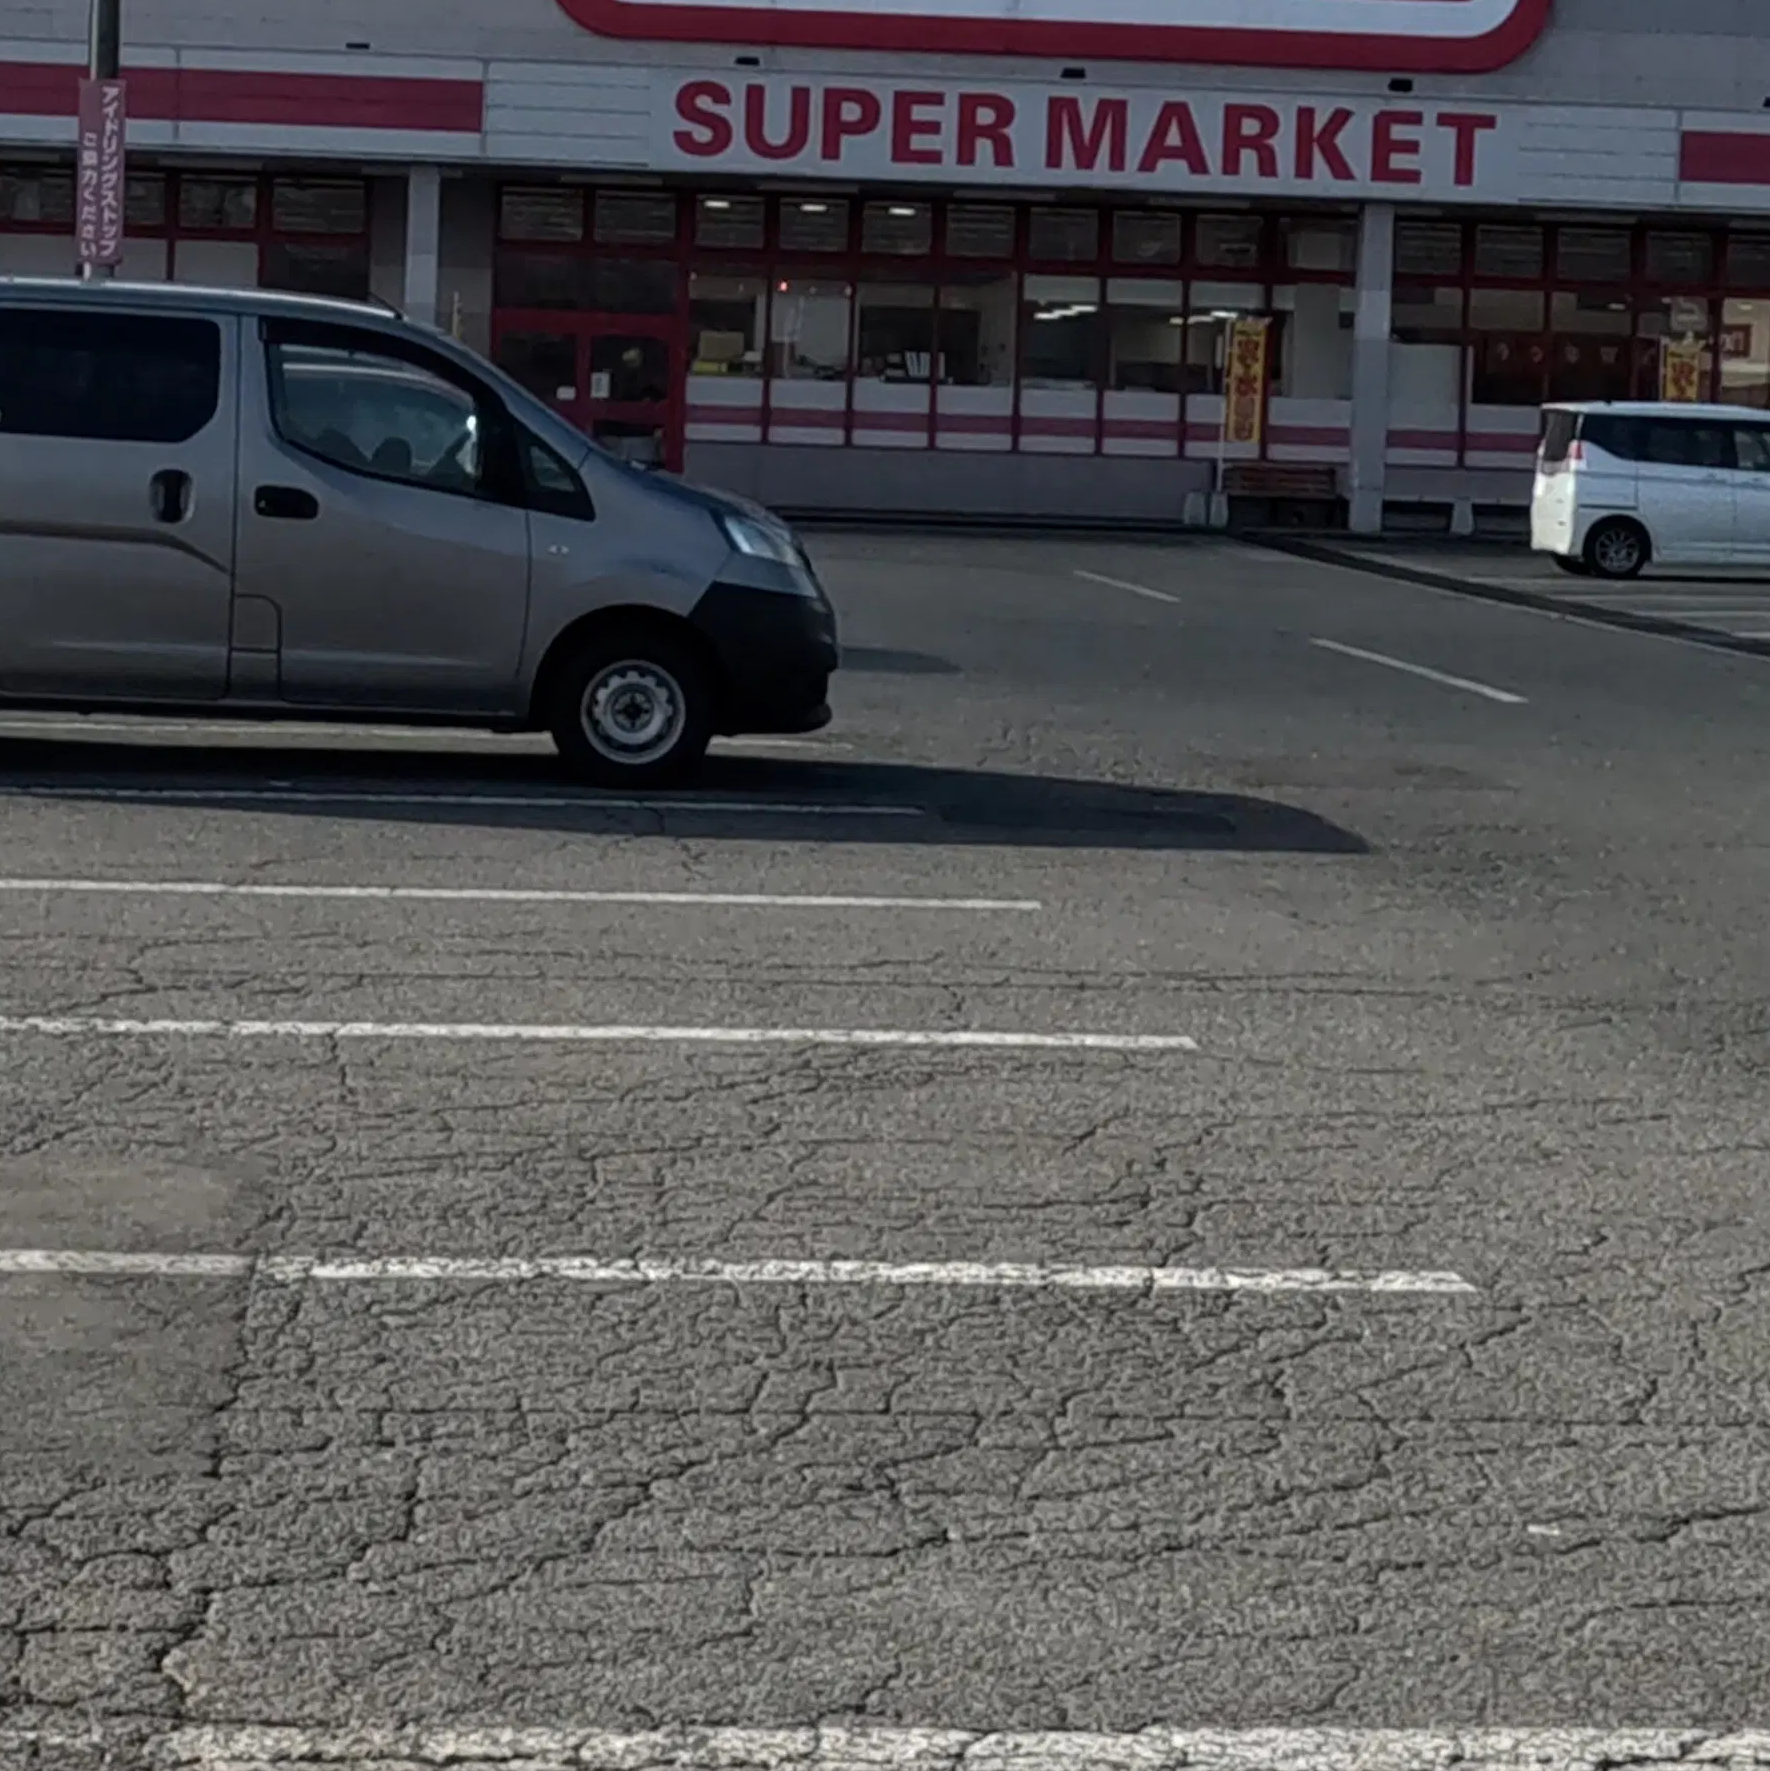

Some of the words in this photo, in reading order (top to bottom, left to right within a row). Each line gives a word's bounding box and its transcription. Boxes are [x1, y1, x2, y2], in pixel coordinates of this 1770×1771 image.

[99, 86, 120, 257] アイドリングストップ
[673, 80, 1015, 167] SUPER
[1045, 96, 1497, 186] MARKET
